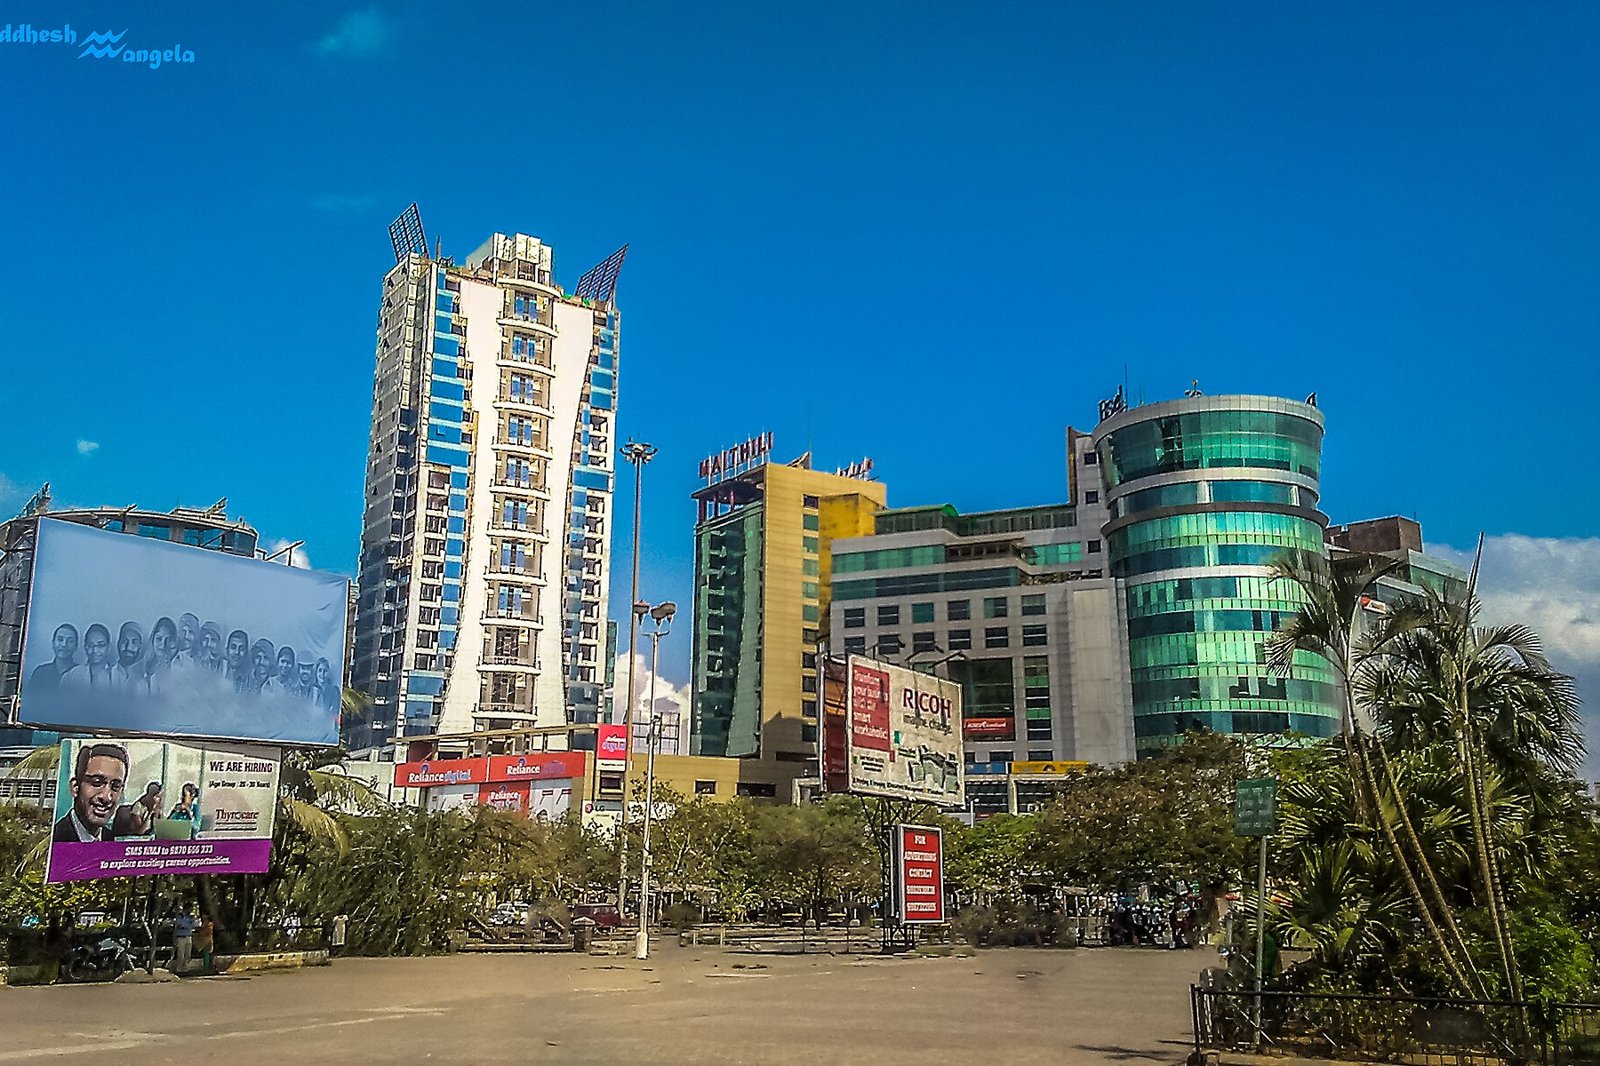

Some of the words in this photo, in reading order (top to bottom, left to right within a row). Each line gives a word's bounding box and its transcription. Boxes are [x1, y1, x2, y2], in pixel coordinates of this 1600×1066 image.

[902, 687, 952, 719] RICOH
[209, 761, 225, 772] WE
[225, 761, 243, 772] ARE
[244, 762, 273, 773] HIRING
[506, 764, 541, 775] Reliance
